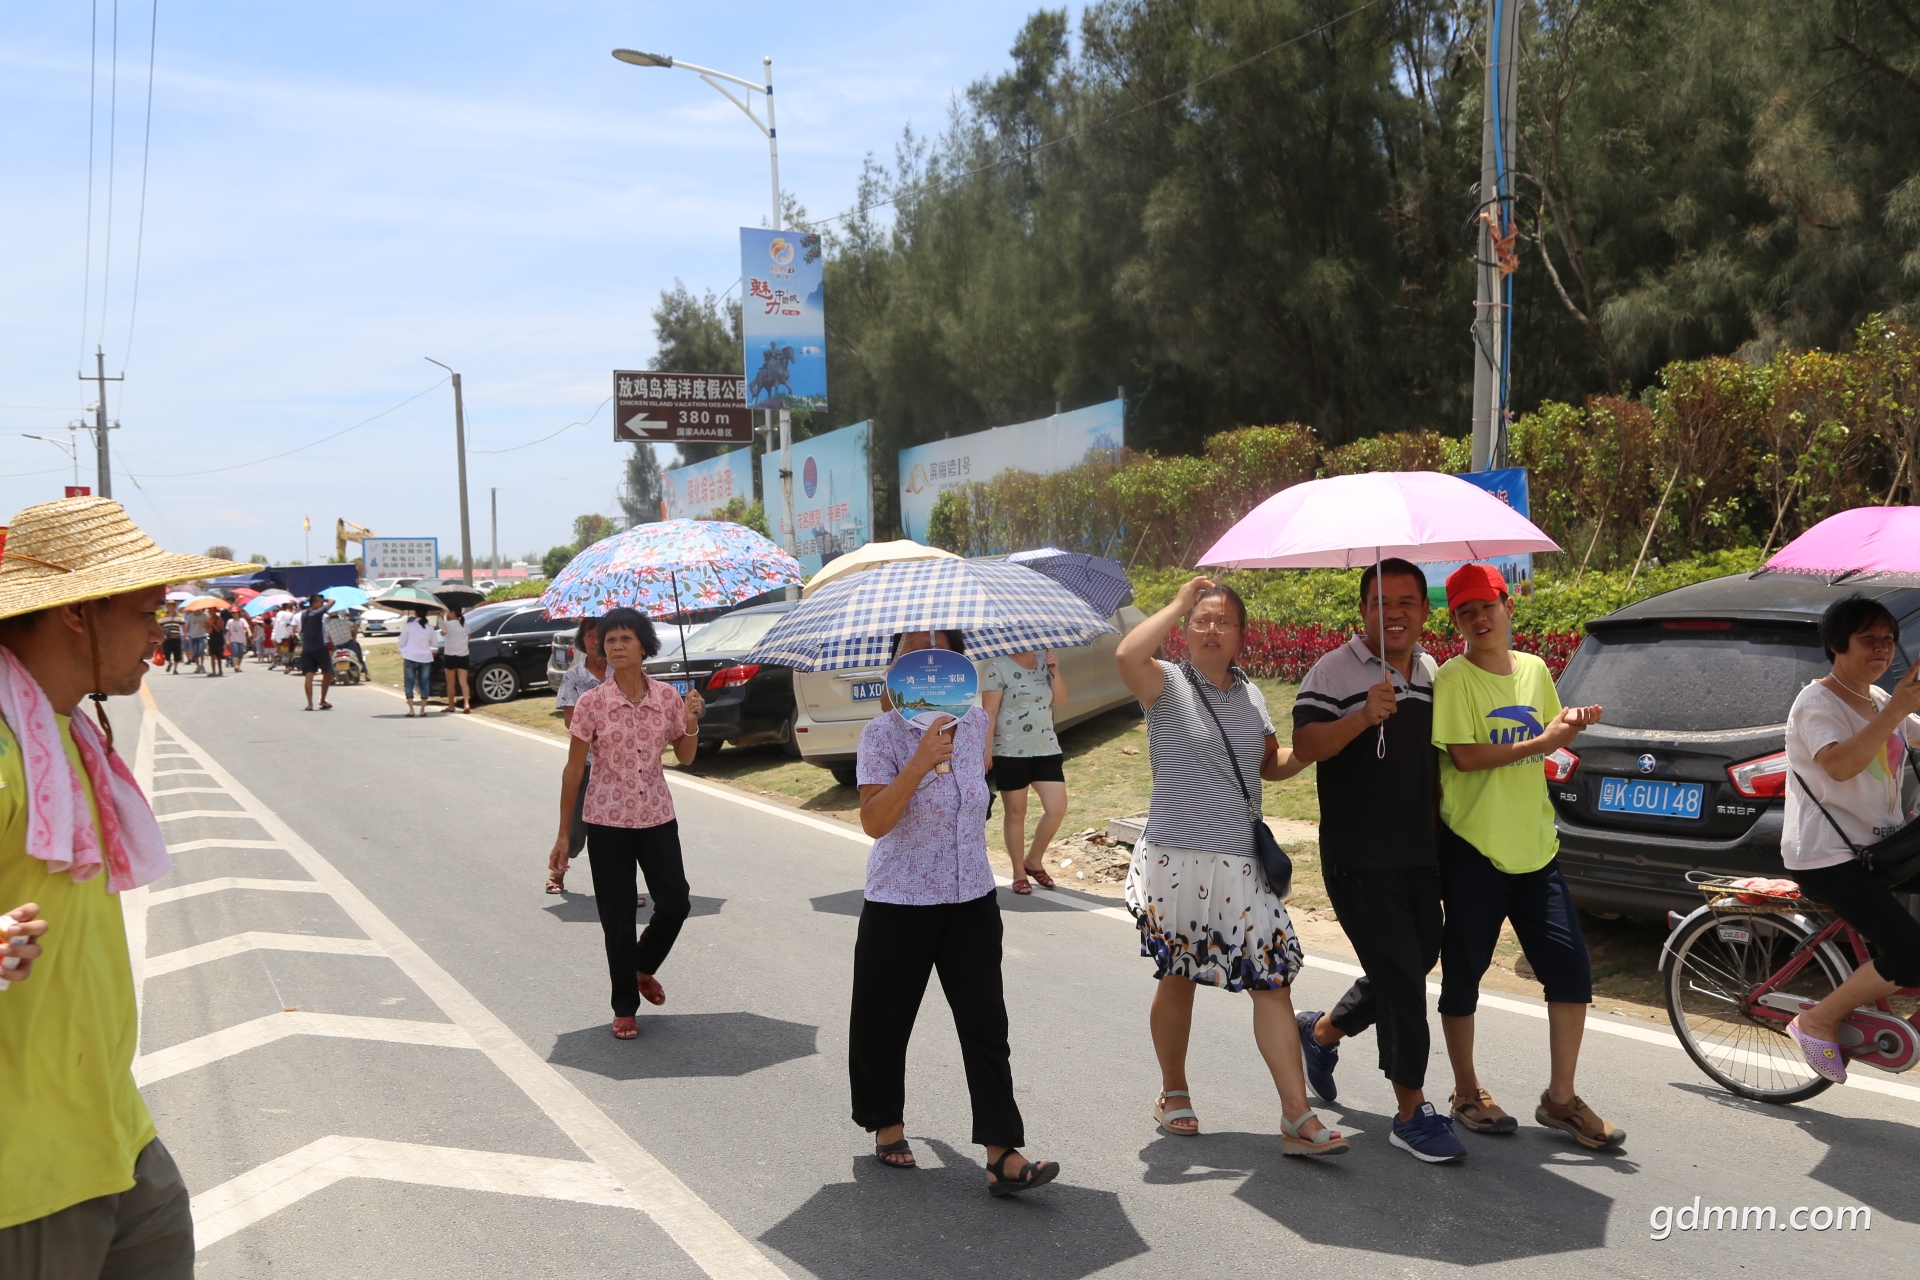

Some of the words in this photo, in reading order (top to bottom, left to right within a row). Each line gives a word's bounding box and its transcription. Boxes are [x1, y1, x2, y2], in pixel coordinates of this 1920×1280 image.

[618, 377, 746, 400] 放鸡岛海洋度假公园
[678, 411, 710, 424] 380
[716, 414, 730, 424] m
[676, 428, 733, 437] 国家AAAA景区
[1560, 792, 1578, 802] R50
[1717, 805, 1756, 816] 东风日产
